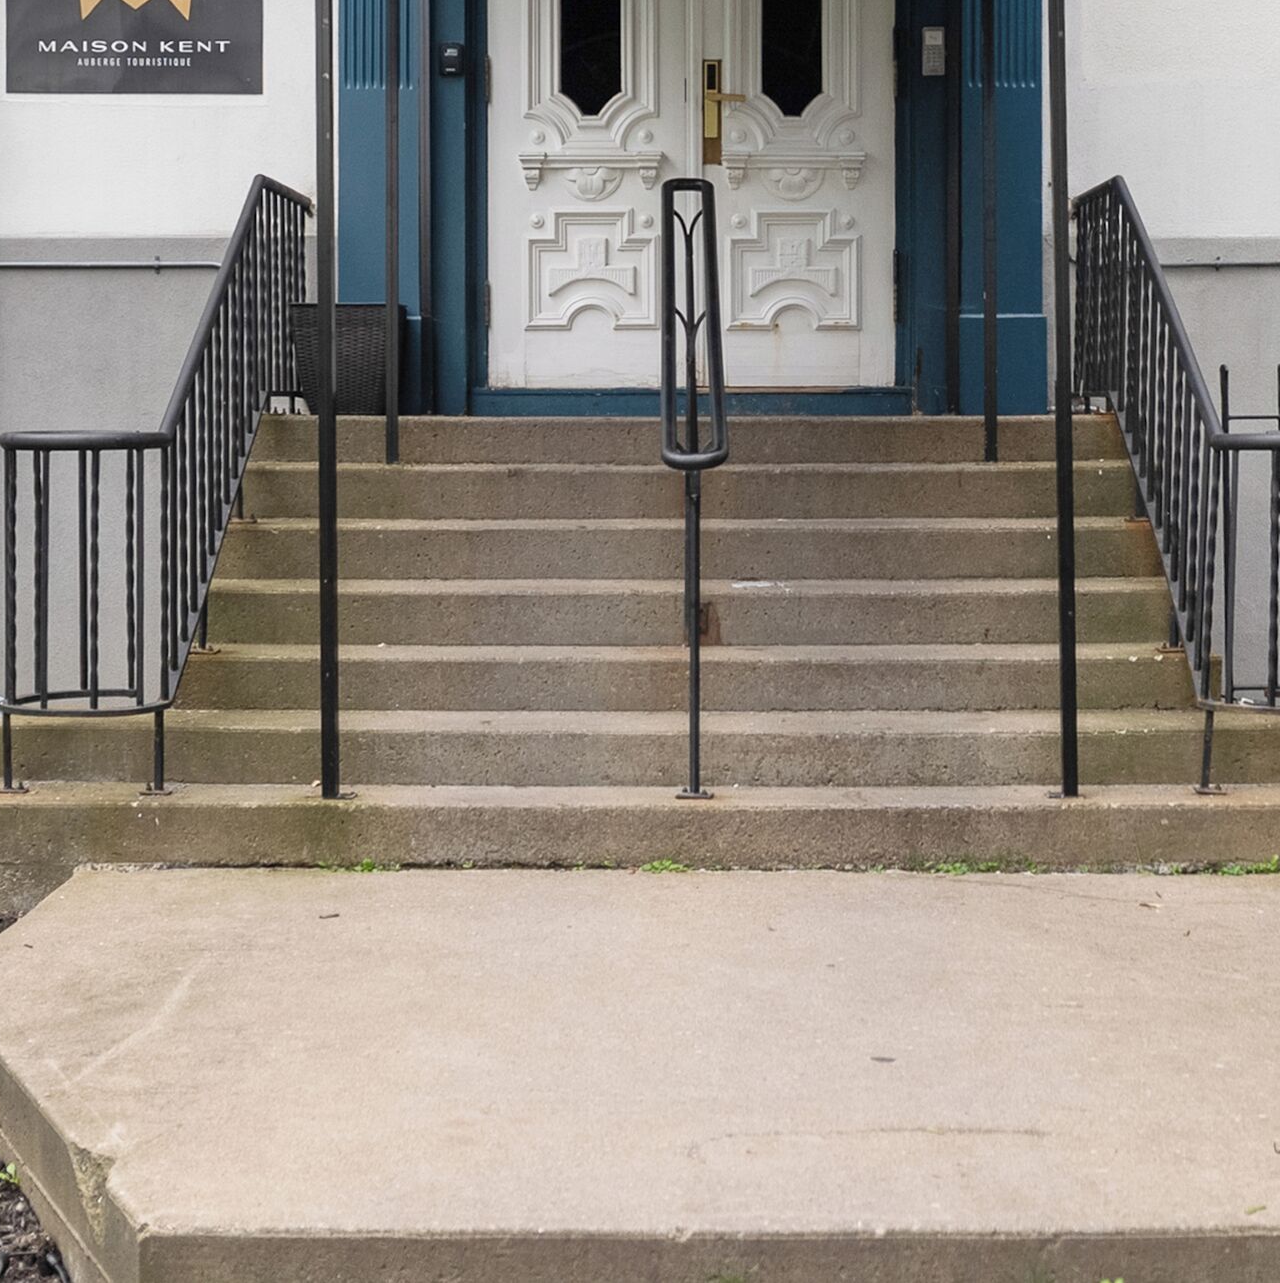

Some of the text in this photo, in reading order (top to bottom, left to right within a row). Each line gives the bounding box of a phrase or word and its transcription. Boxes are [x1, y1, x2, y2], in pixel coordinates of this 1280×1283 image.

[38, 39, 231, 53] MAISON KENT
[76, 57, 192, 67] AUBERGE TOURISTIQUE
